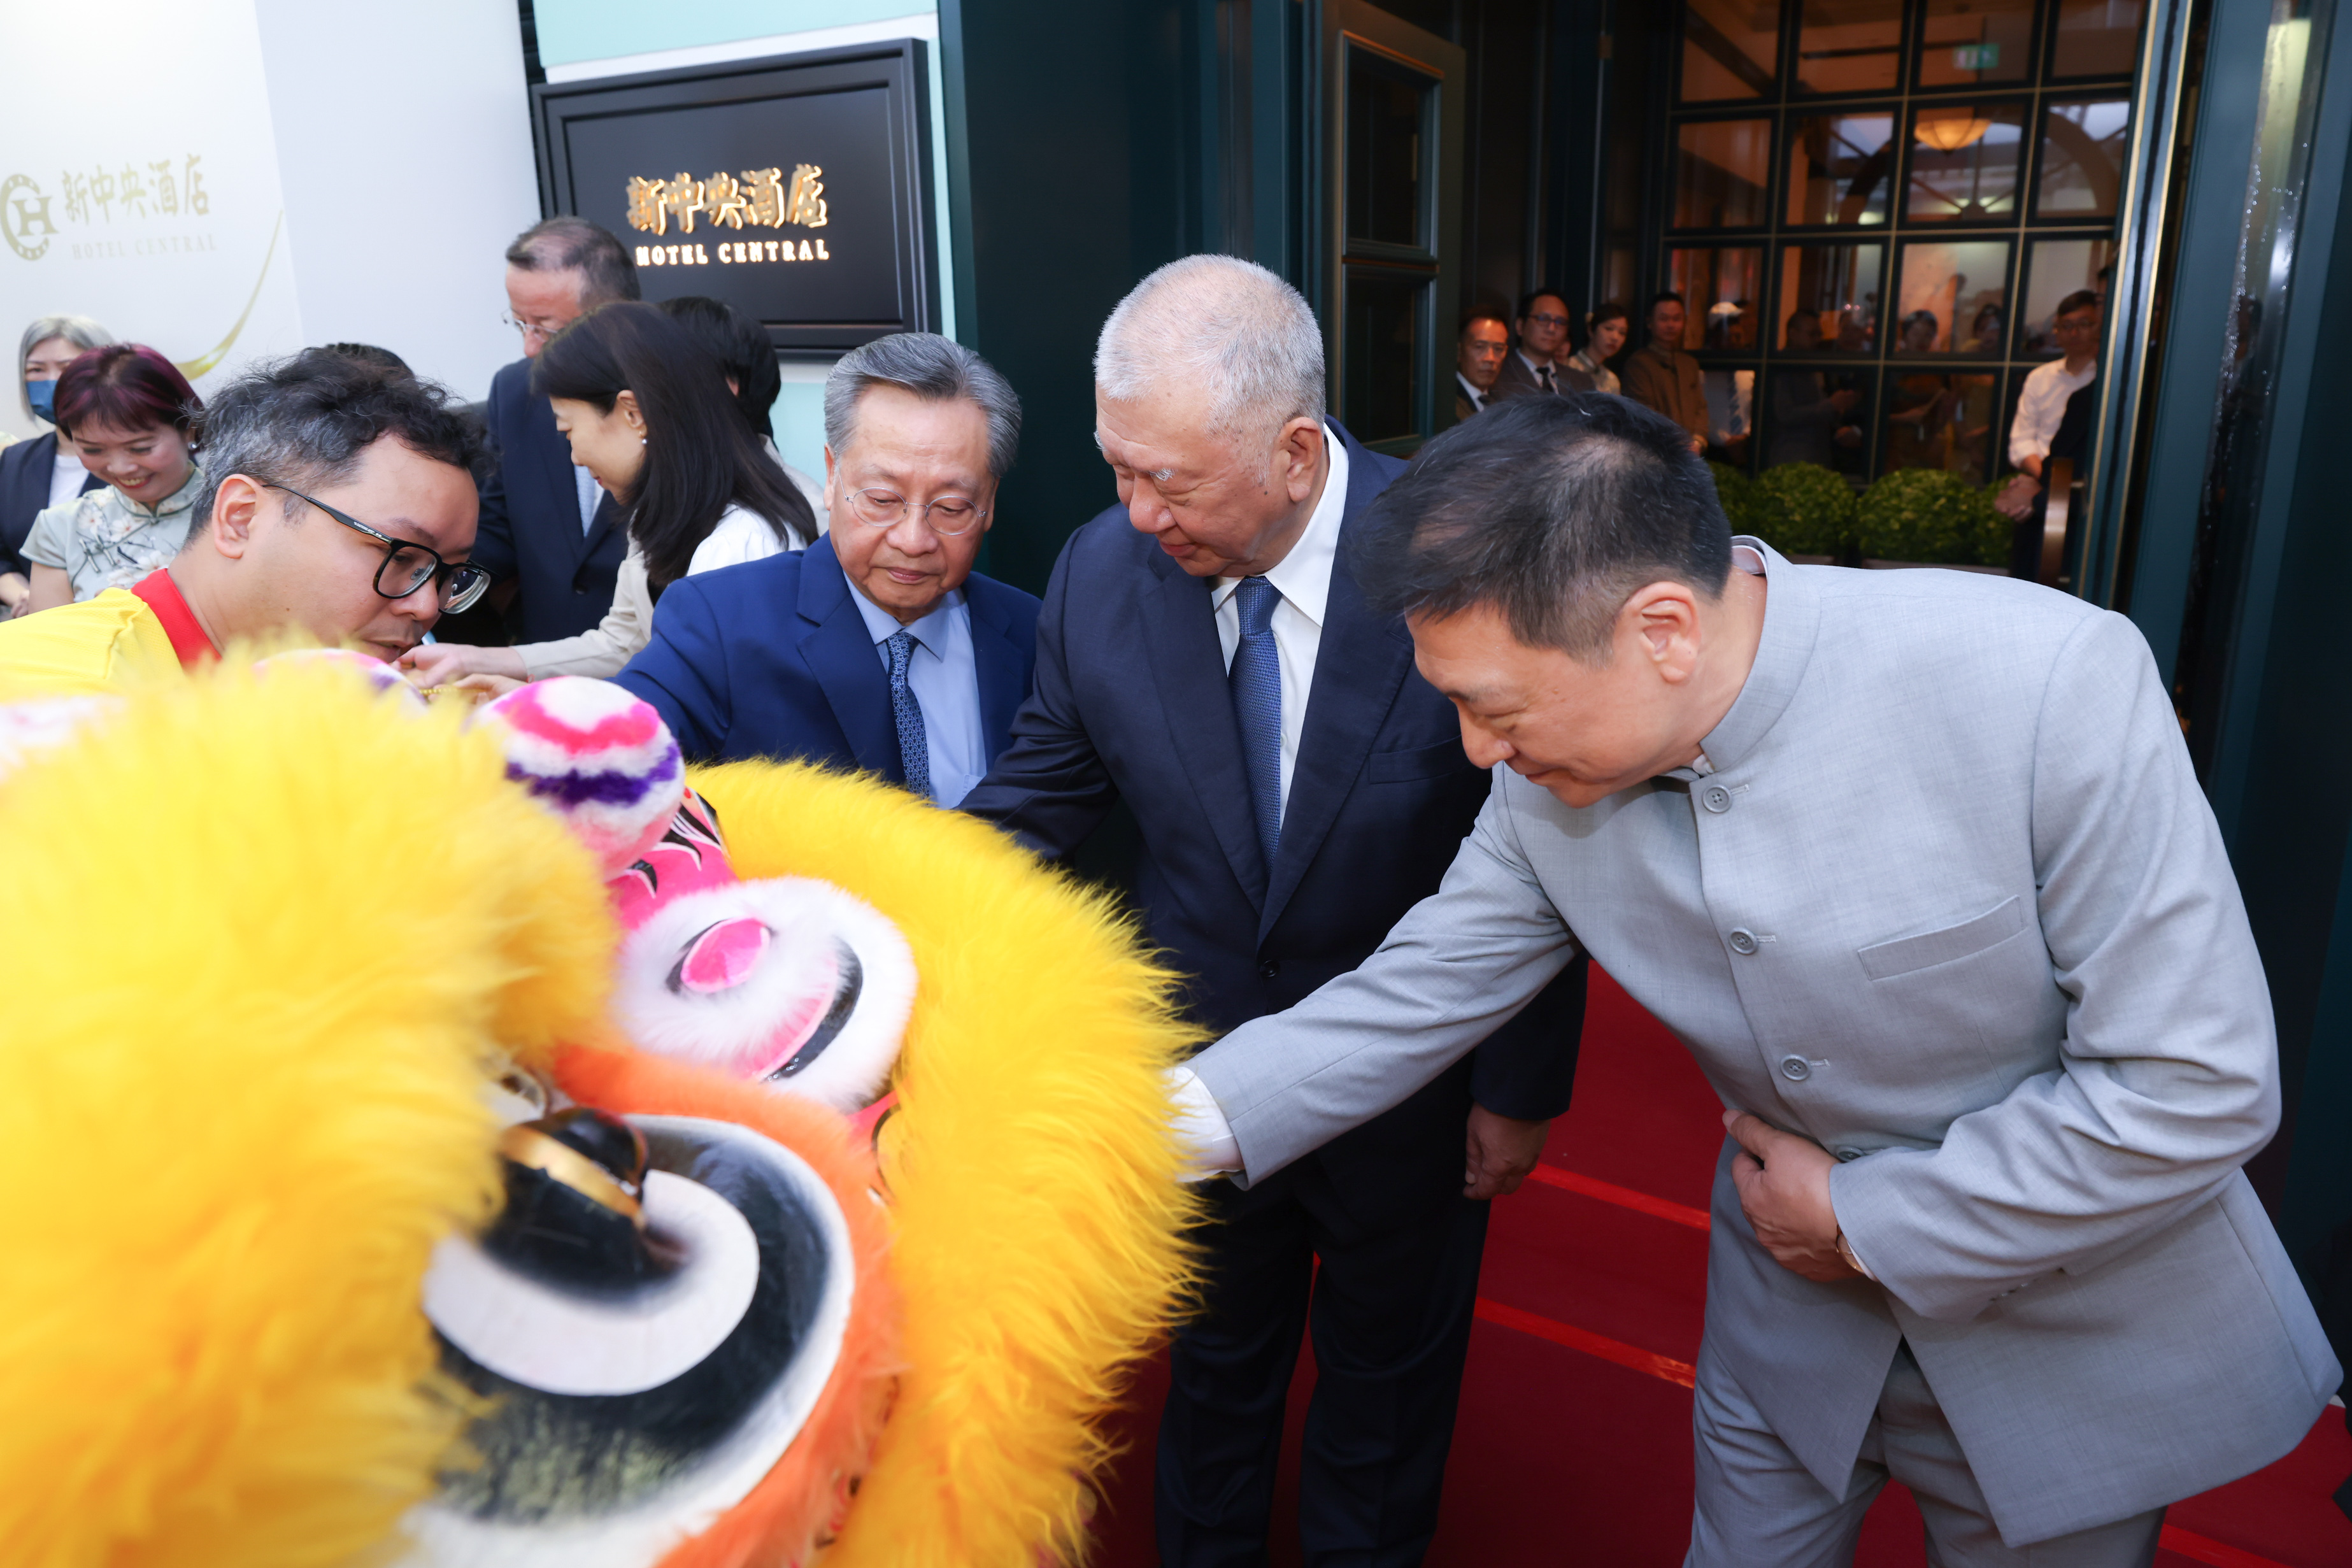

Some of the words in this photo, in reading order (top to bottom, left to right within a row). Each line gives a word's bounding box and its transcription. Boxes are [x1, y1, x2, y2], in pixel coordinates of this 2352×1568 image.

[62, 153, 209, 225] 新中央酒店
[627, 164, 827, 235] 新中央酒店
[72, 241, 125, 259] HOTEL
[135, 234, 217, 255] CENTRAL
[636, 244, 708, 266] HOTEL
[718, 239, 829, 263] CENTRAL
